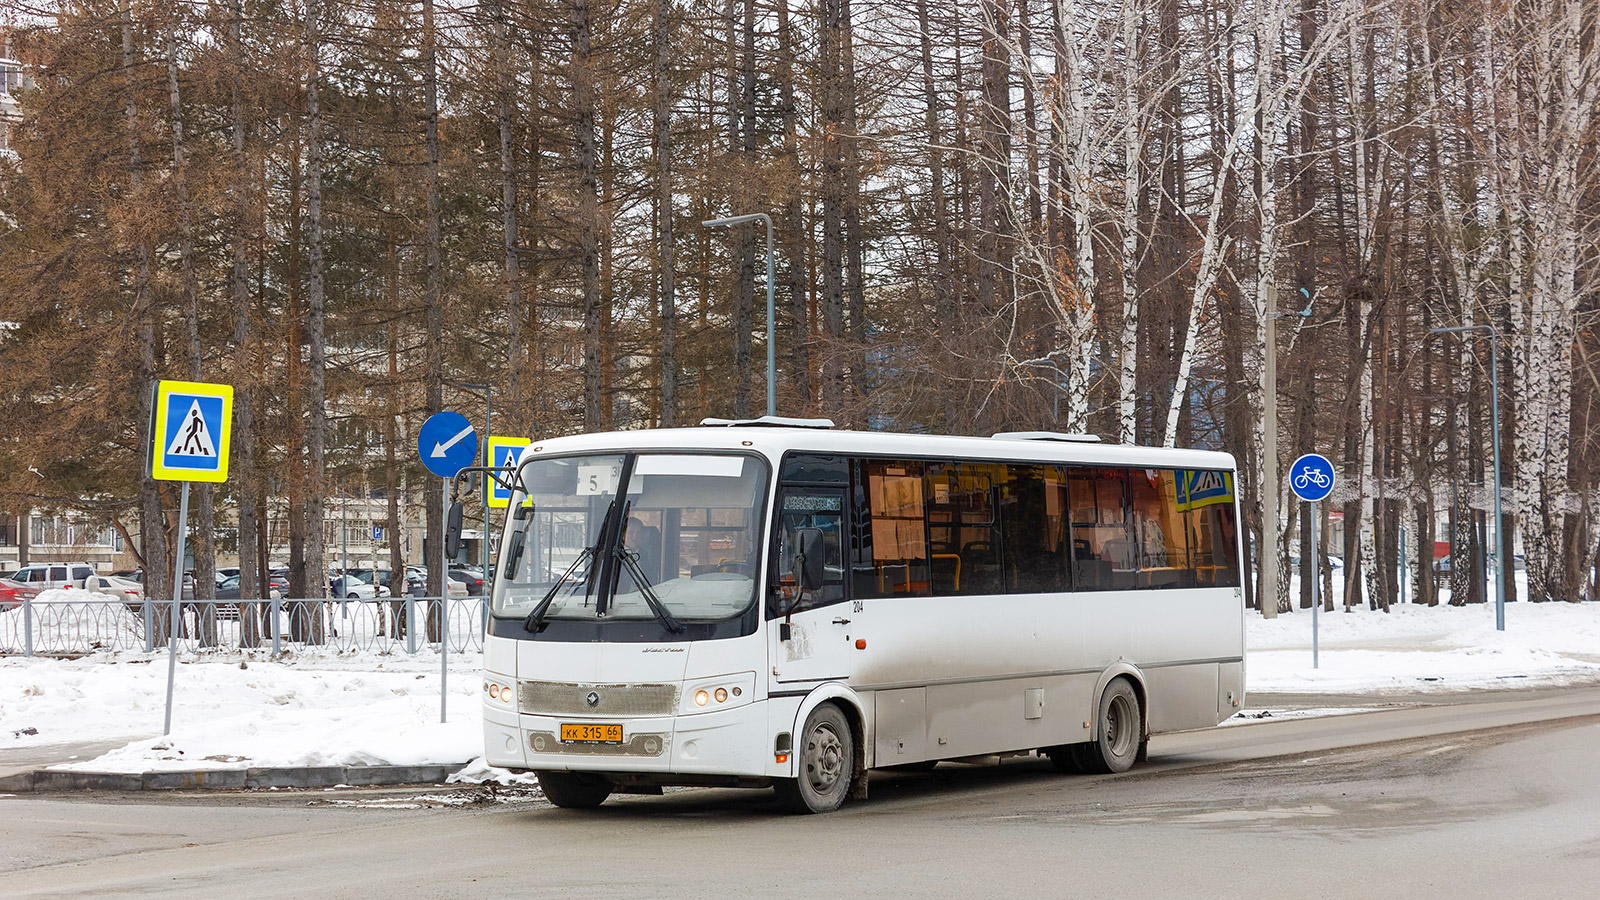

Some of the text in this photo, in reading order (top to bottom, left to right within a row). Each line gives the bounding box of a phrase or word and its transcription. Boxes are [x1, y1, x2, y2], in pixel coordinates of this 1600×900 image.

[589, 475, 598, 492] 5
[853, 601, 864, 613] 204
[582, 727, 602, 739] 315
[607, 726, 618, 736] 66
